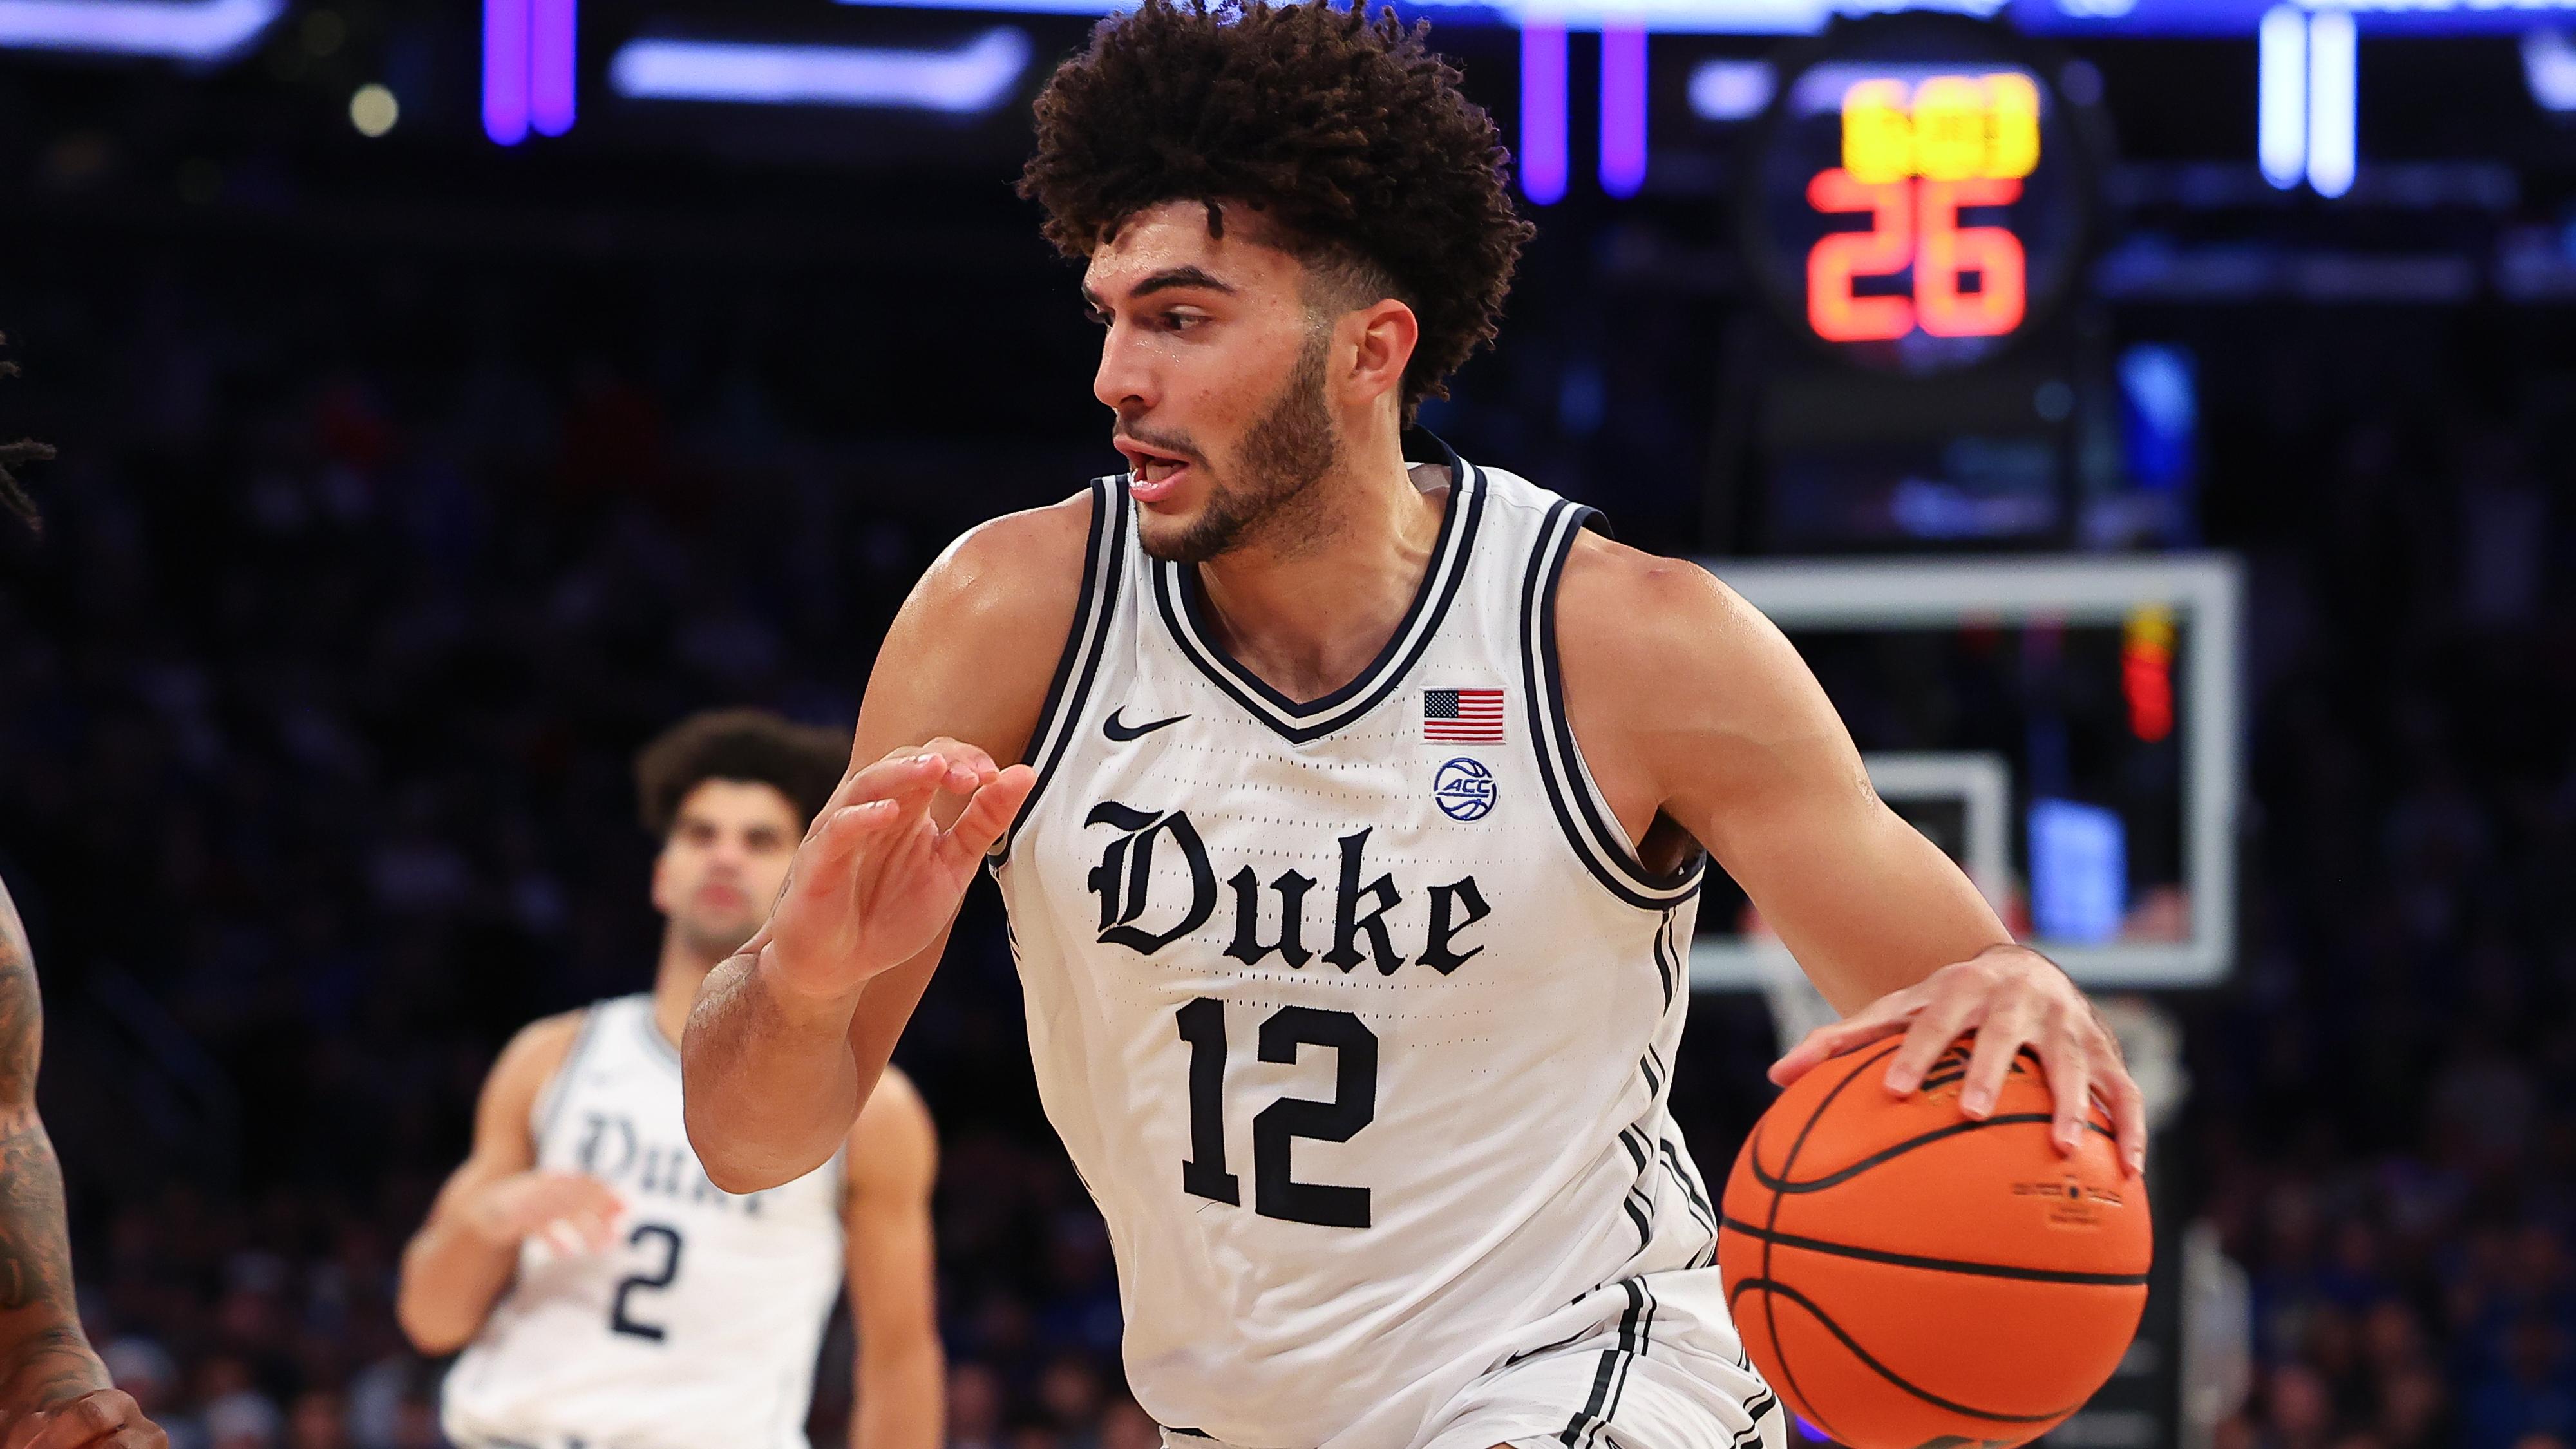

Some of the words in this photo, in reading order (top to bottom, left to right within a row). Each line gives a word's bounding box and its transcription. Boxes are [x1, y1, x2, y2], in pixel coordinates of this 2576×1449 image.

[1806, 167, 2026, 343] 26
[1442, 778, 1493, 793] ACC
[1084, 800, 1492, 976] Duke
[1175, 996, 1378, 1229] 12
[609, 1222, 683, 1343] 2
